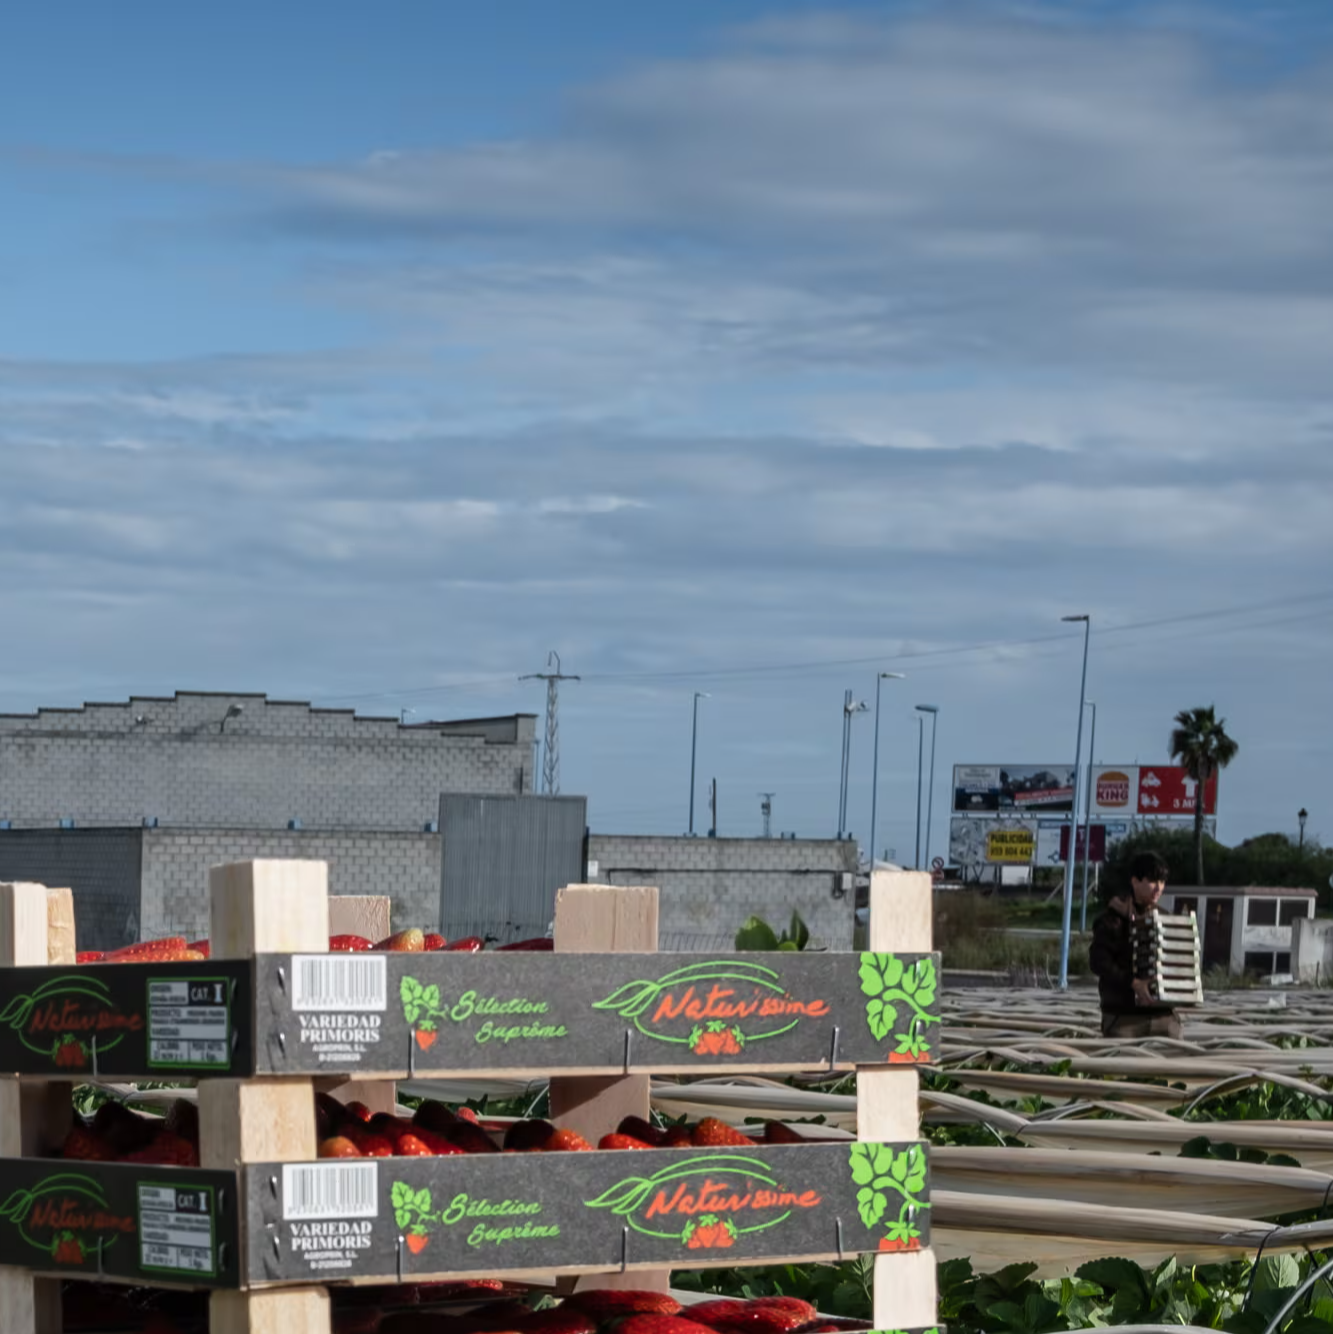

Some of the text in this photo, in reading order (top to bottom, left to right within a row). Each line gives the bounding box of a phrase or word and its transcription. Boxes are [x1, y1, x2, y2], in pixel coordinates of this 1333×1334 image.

[1096, 788, 1128, 802] KING
[653, 985, 829, 1022] Naturissime
[299, 1014, 381, 1027] VARIEDAD
[300, 1029, 380, 1043] PRIMORIS
[645, 1180, 821, 1219] Naturissime
[290, 1222, 372, 1236] VARIEDAD
[292, 1235, 371, 1251] PRIMORIS
